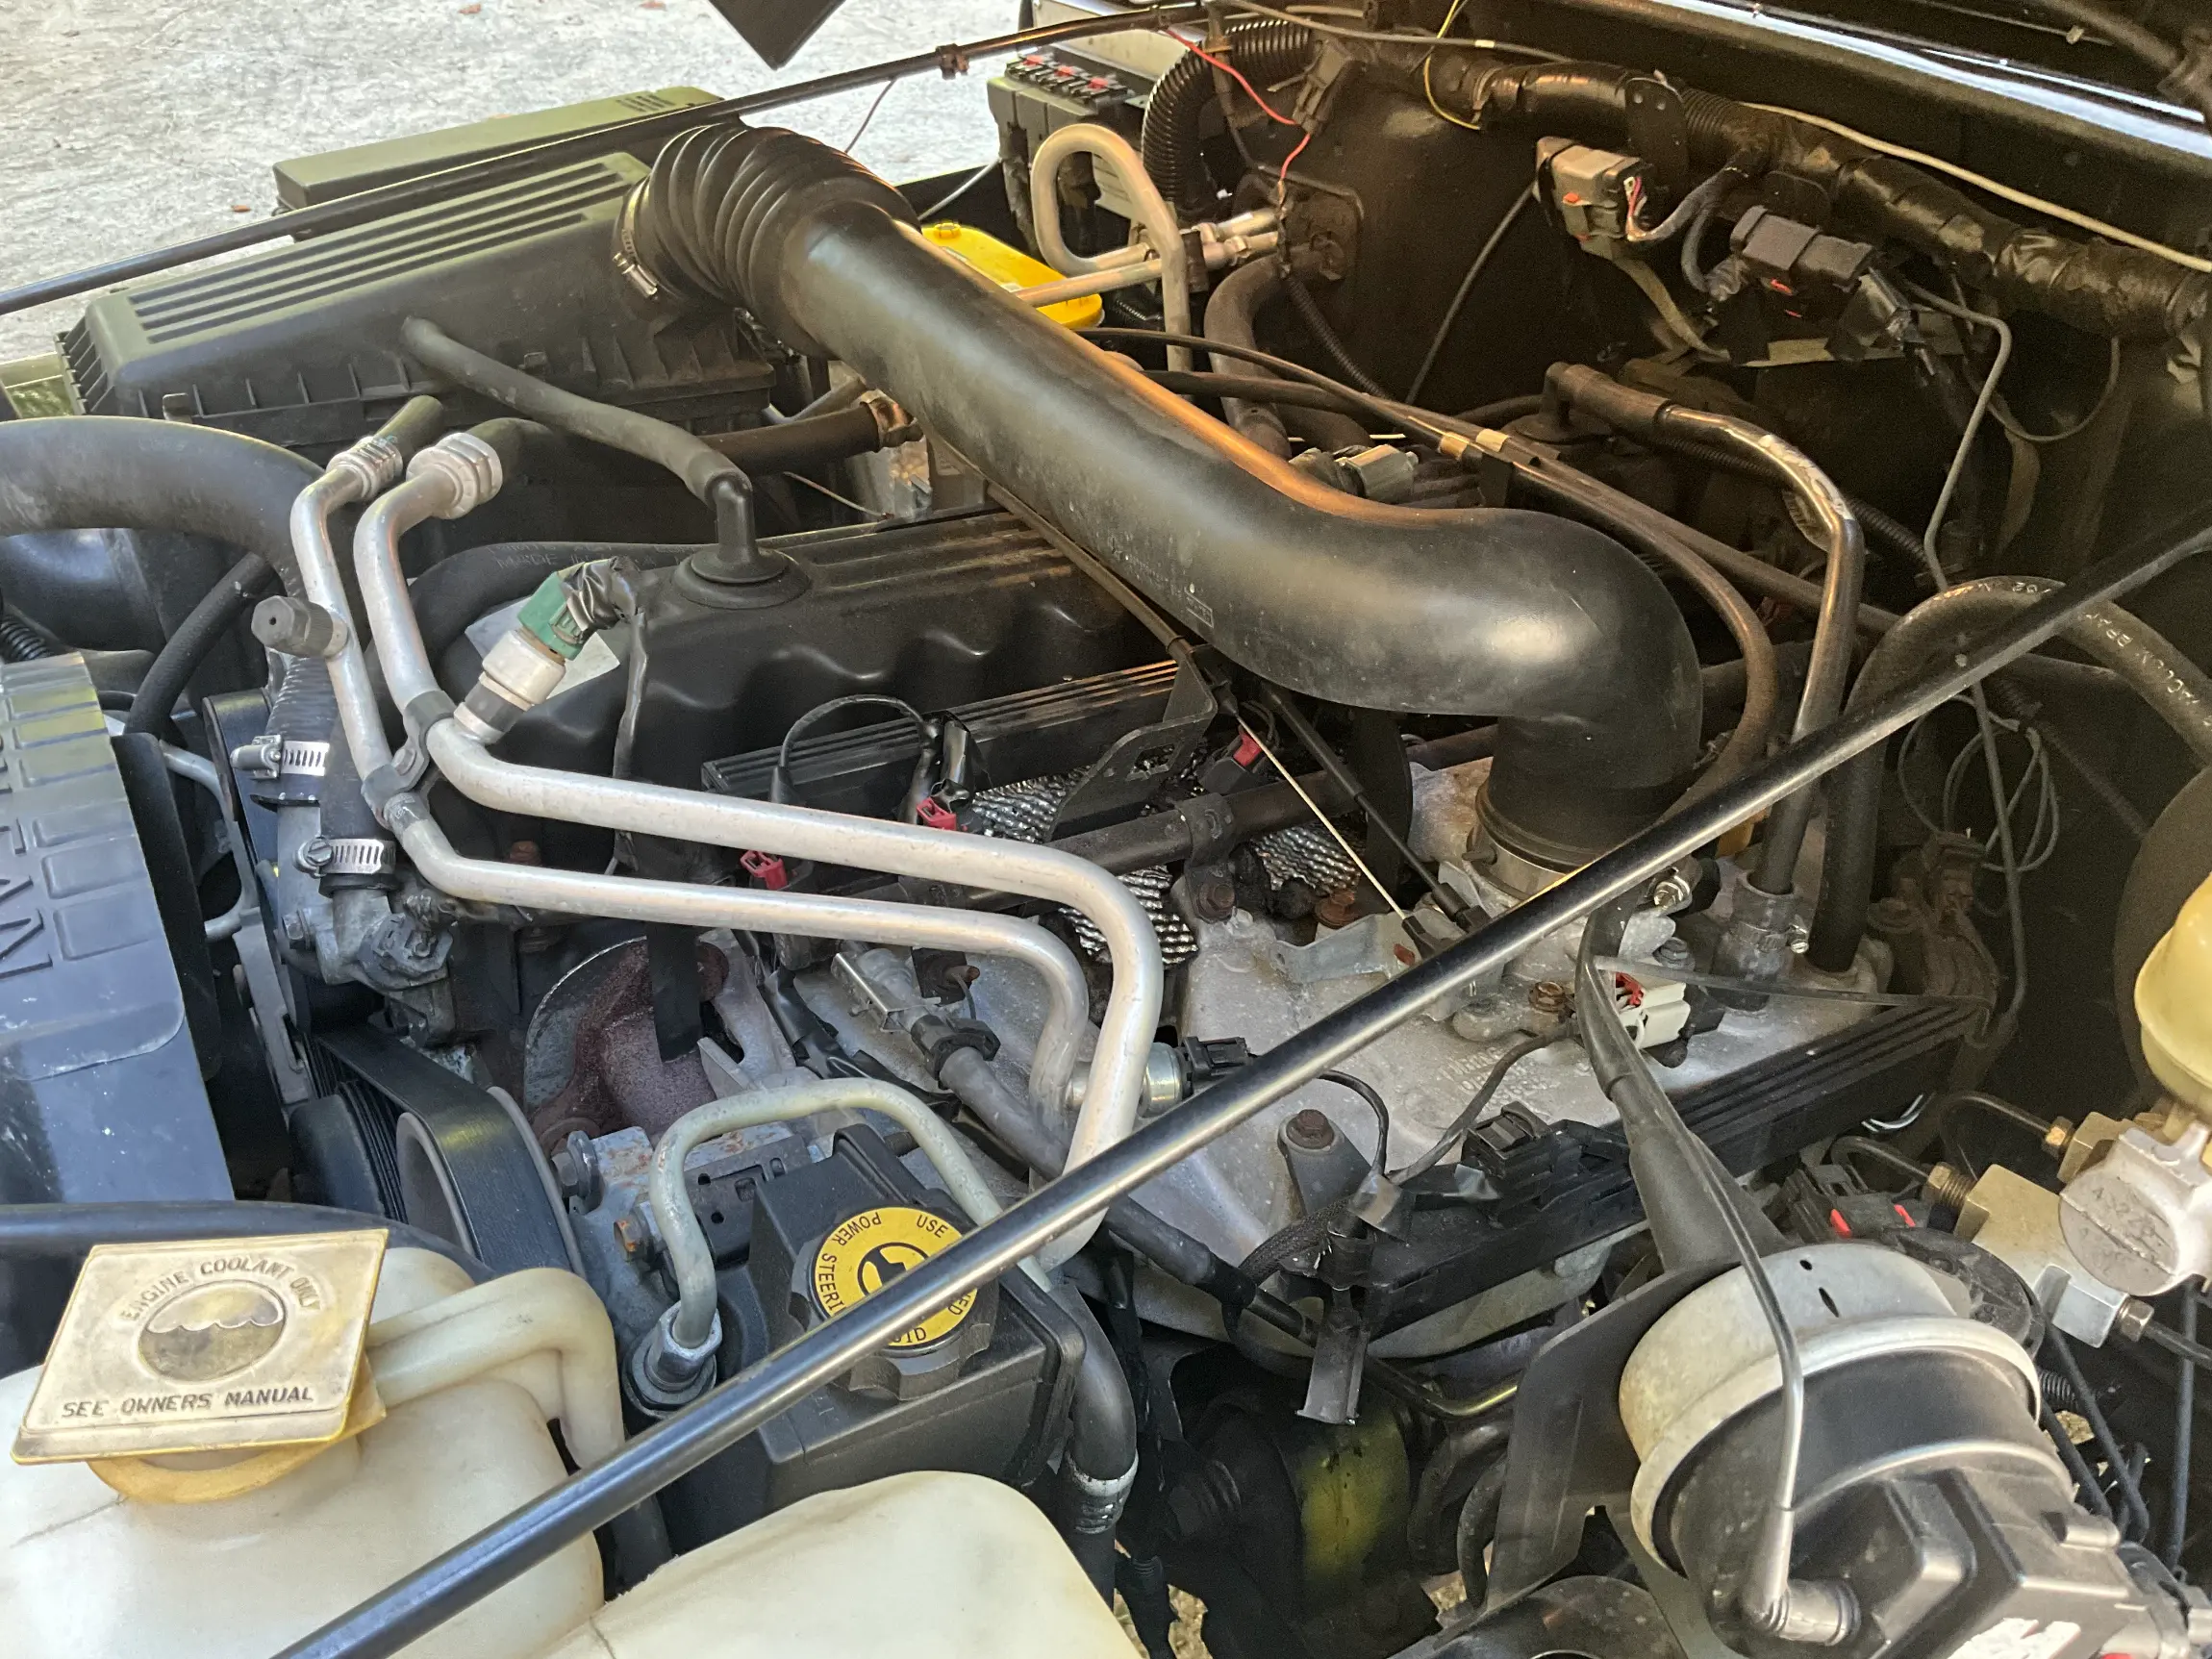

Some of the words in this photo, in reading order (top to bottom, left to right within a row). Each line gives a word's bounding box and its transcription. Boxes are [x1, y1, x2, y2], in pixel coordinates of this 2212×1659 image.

[831, 1211, 883, 1247] POWER
[916, 1214, 948, 1239] USE
[119, 1269, 189, 1321] ENGINE
[199, 1256, 295, 1280] COOLANT
[289, 1275, 322, 1311] ONLY
[817, 1252, 847, 1315] STEERI
[61, 1398, 110, 1419] SEE
[119, 1392, 214, 1417] OWNERS
[223, 1385, 314, 1408] MANUAL
